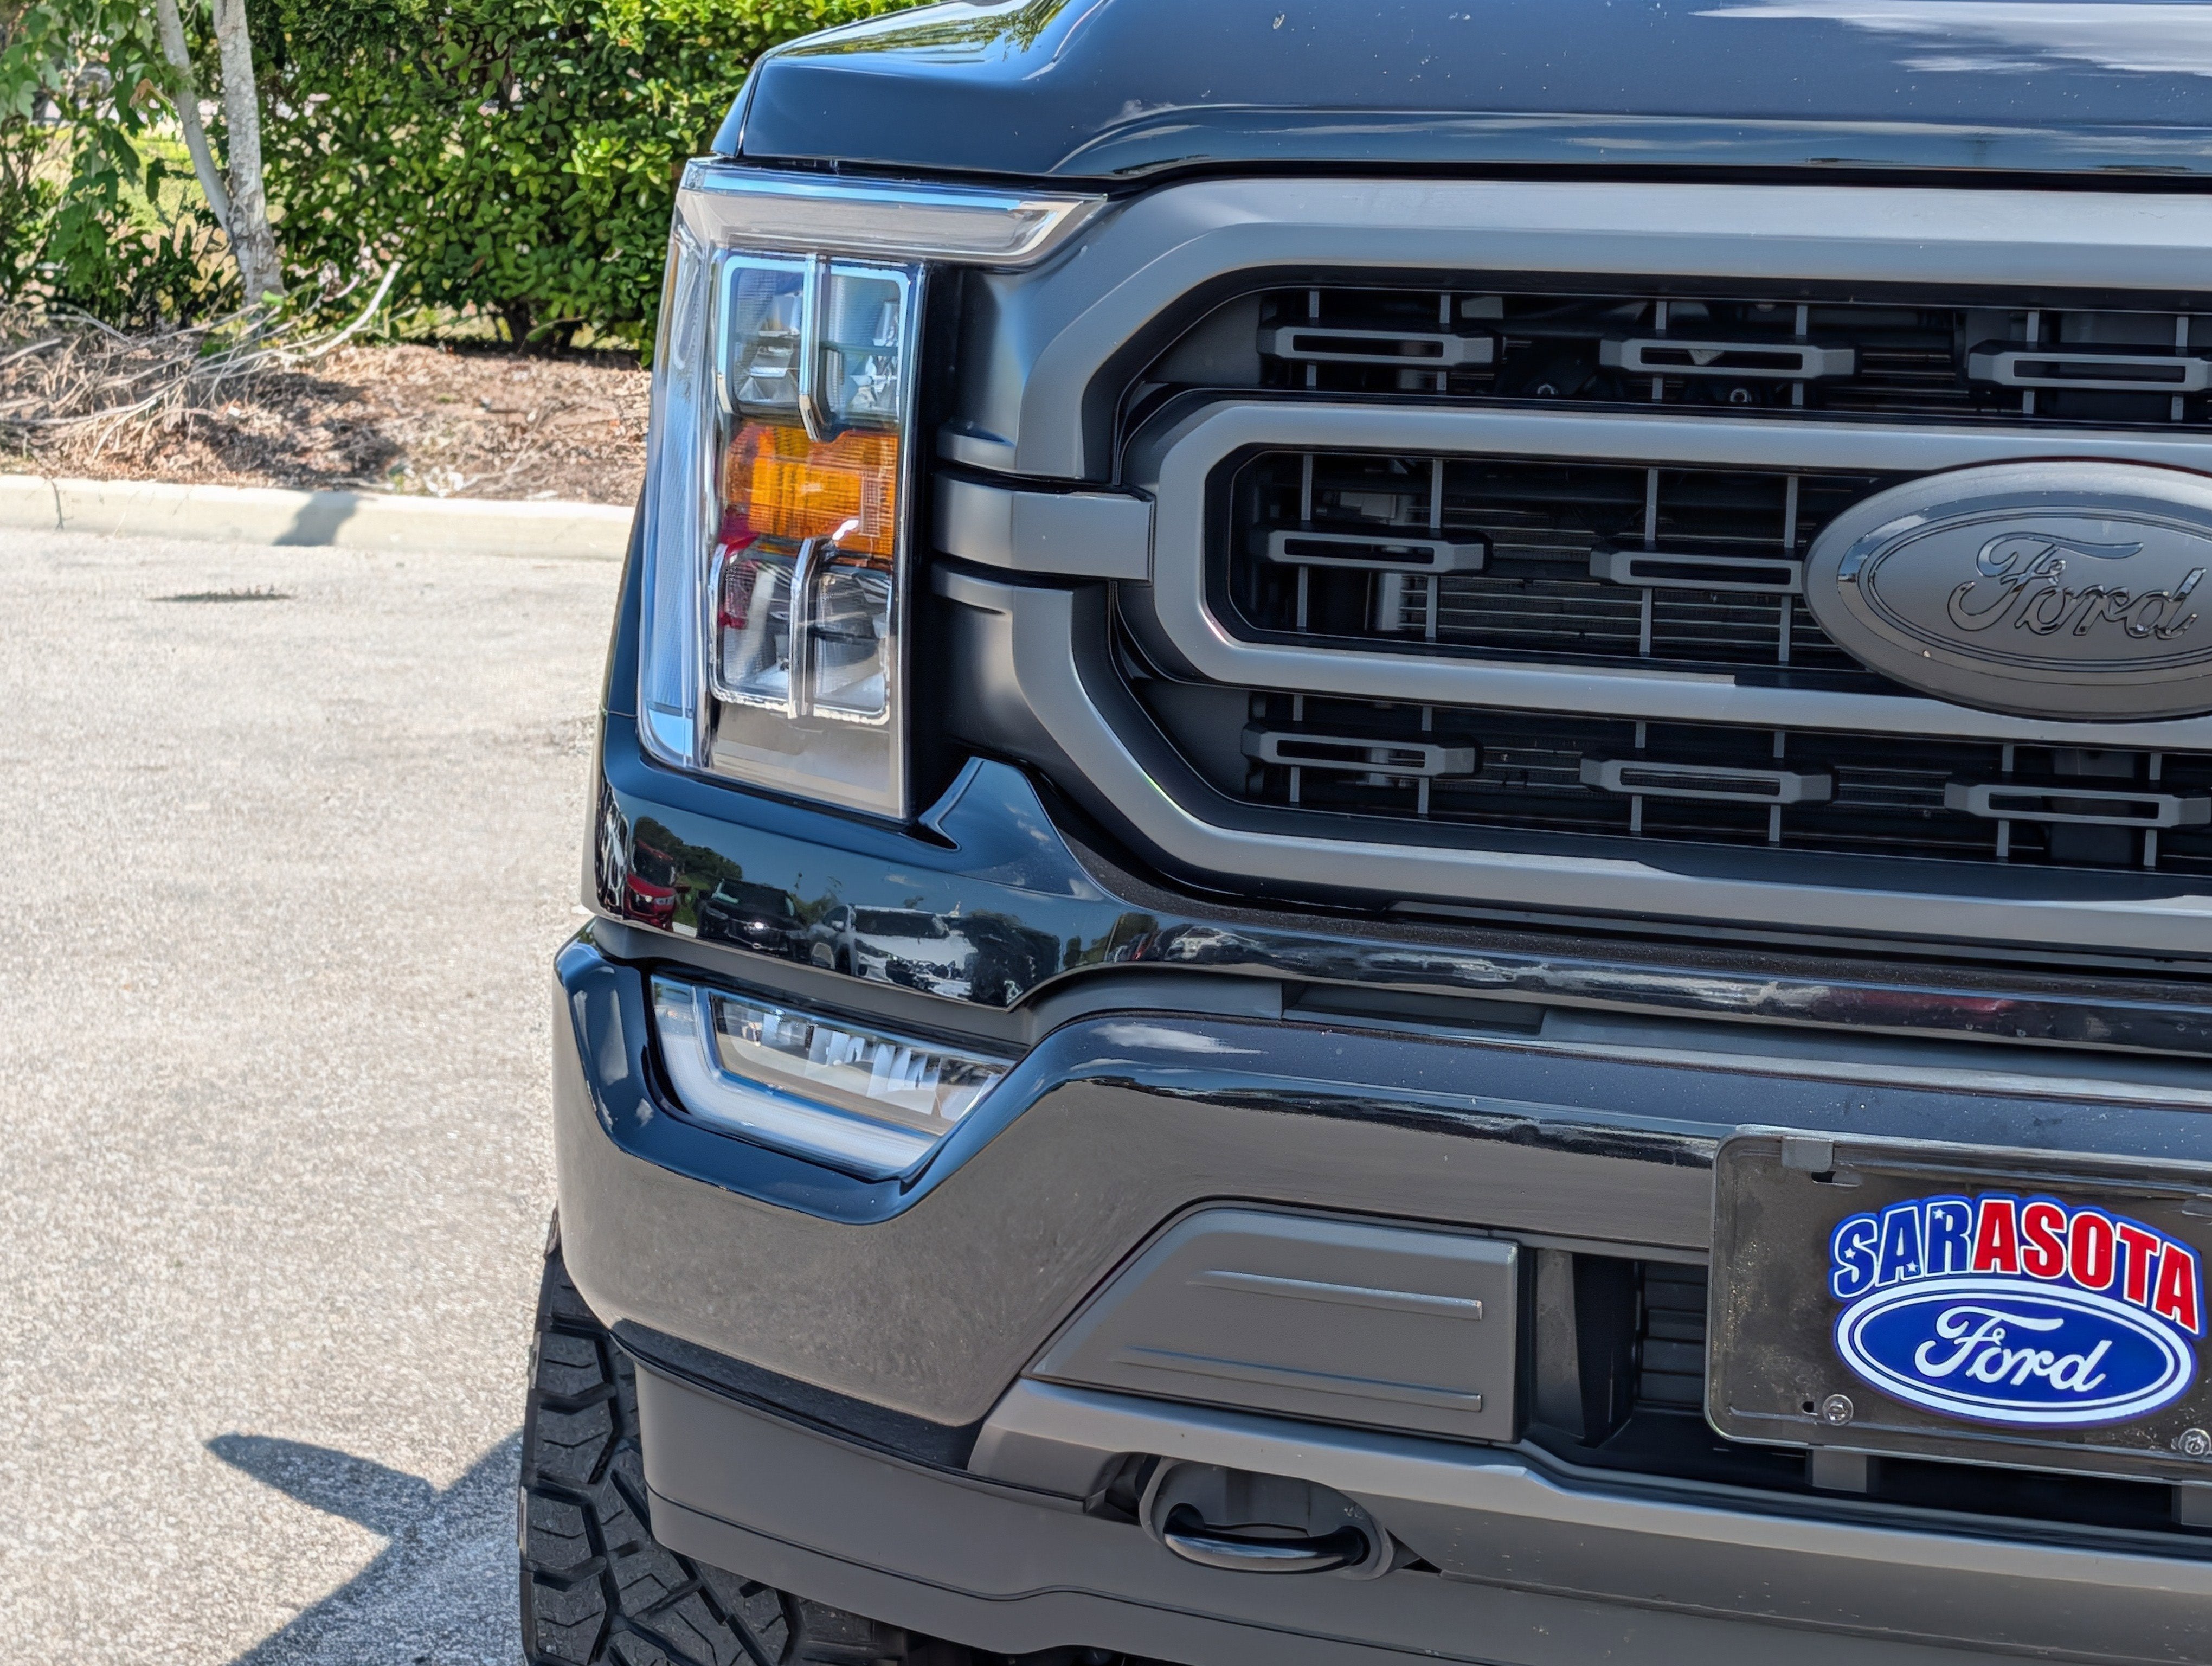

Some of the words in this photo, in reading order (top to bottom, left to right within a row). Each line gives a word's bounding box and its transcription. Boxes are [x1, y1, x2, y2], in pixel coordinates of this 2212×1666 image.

[1946, 532, 2207, 639] Ford
[1833, 1199, 2200, 1335] SARASOTA
[1914, 1306, 2113, 1392] Ford
